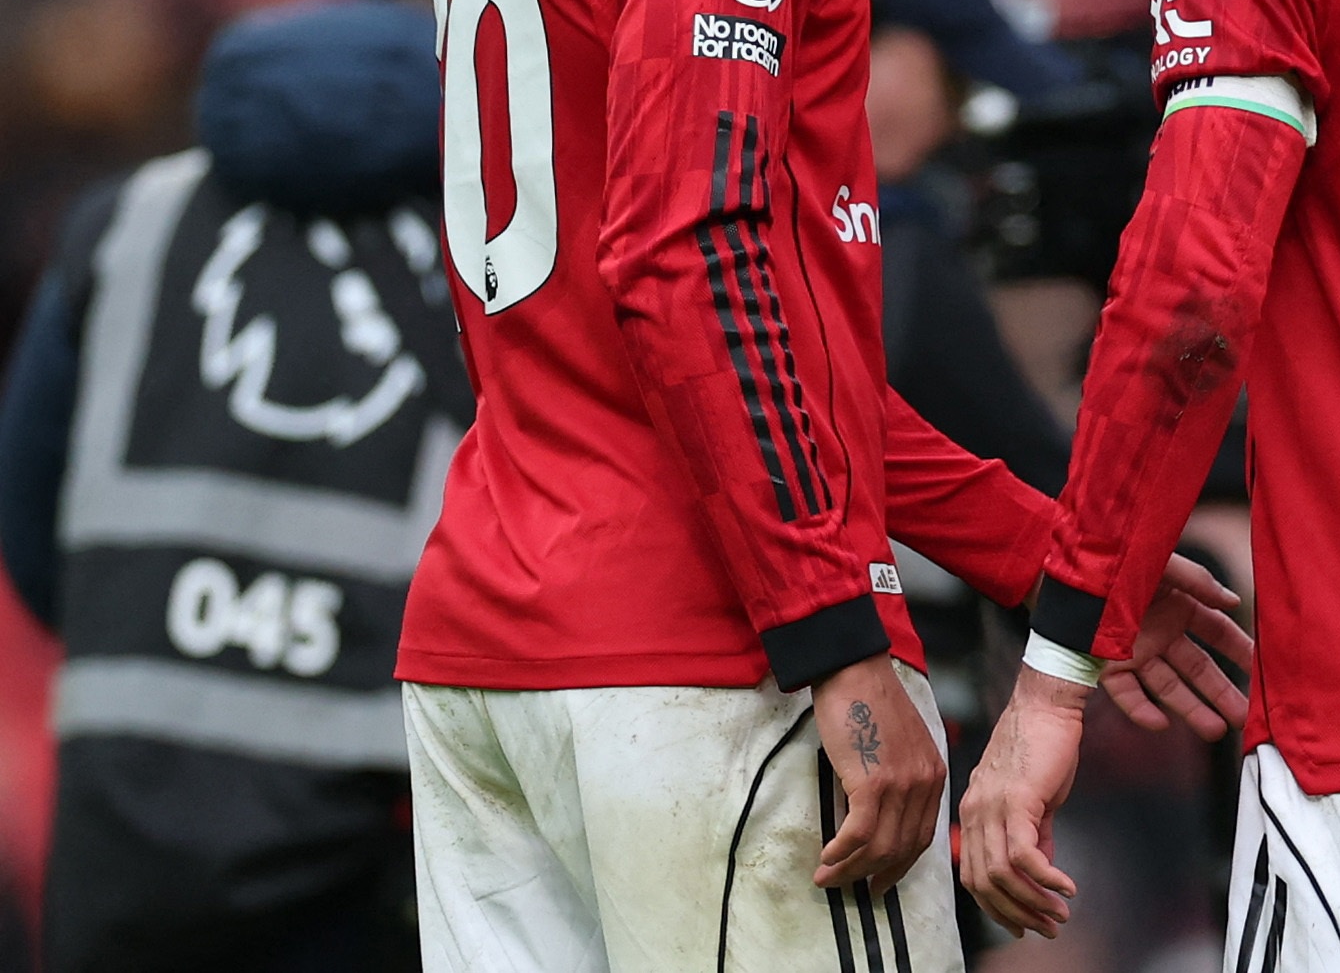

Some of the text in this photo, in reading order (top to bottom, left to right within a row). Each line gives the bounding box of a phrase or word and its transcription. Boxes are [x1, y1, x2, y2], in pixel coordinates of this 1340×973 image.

[693, 34, 779, 78] for racism
[694, 14, 778, 55] No room
[165, 556, 344, 677] 045
